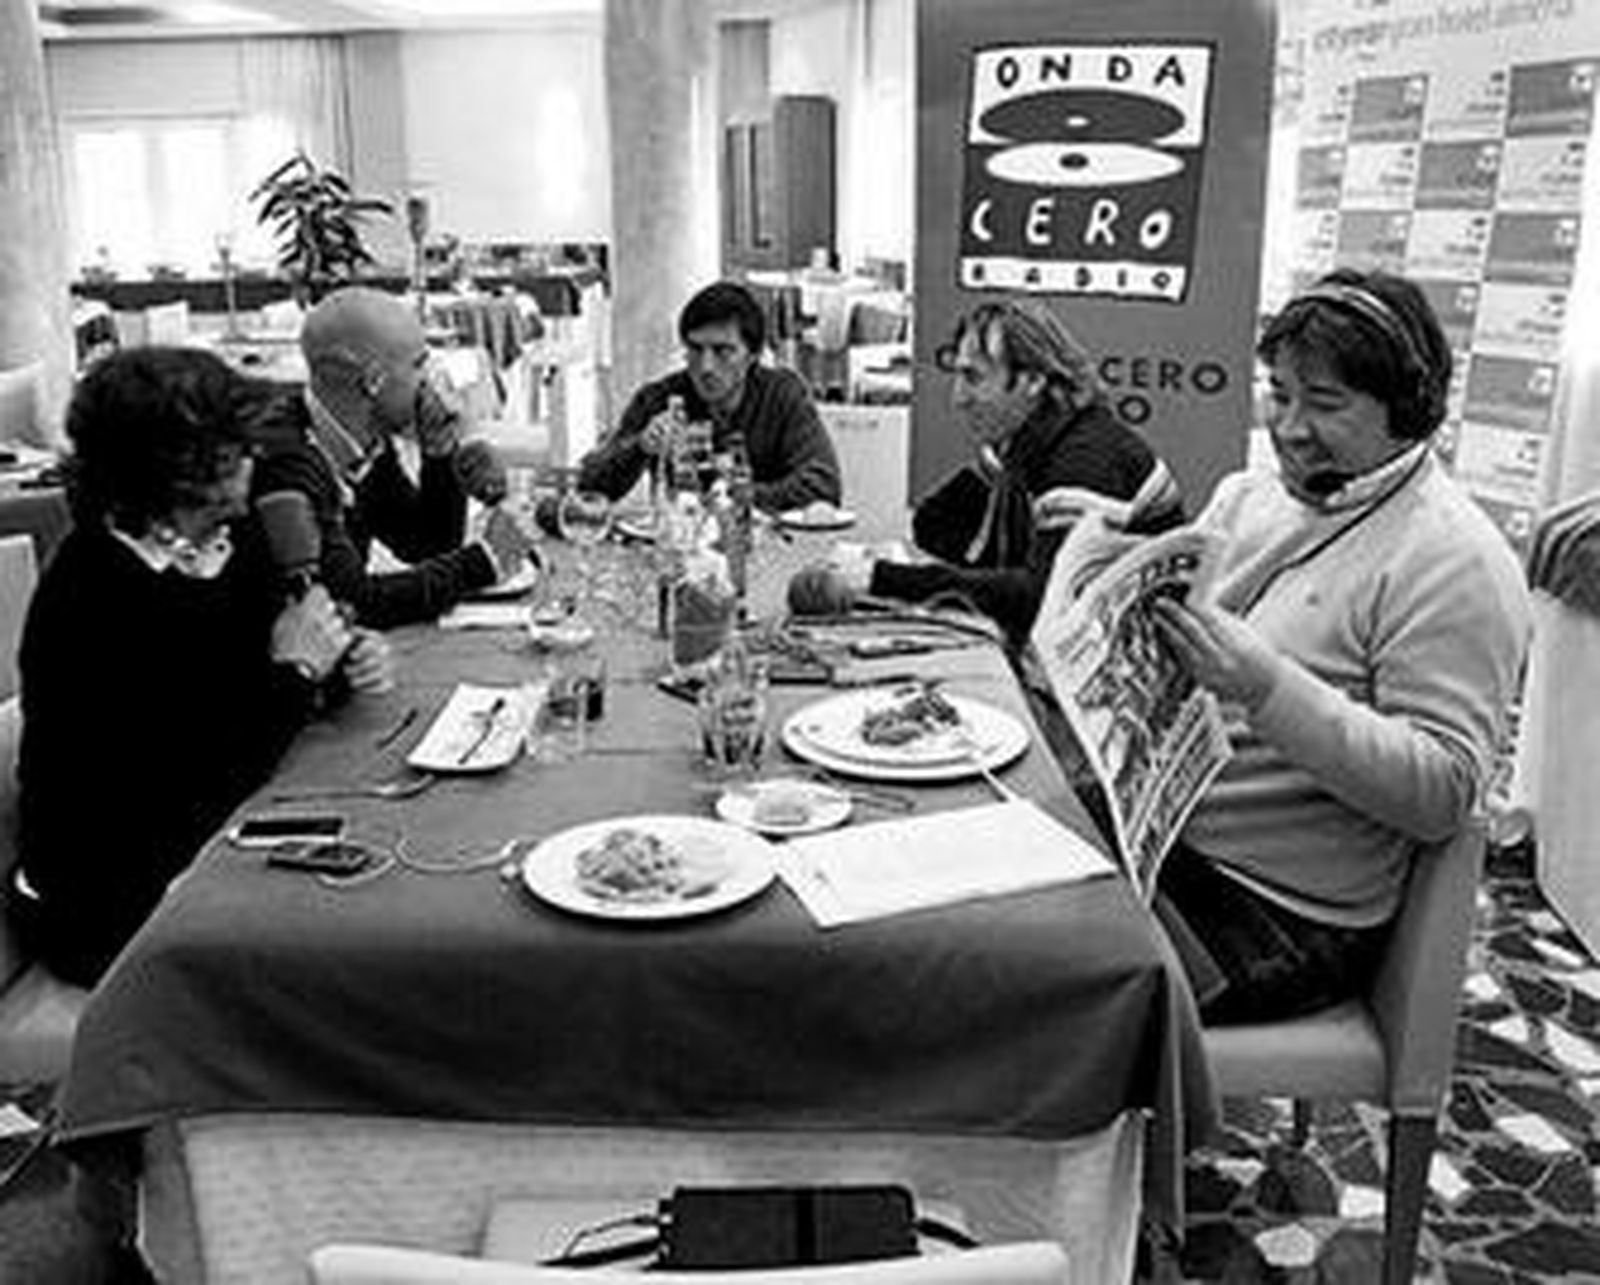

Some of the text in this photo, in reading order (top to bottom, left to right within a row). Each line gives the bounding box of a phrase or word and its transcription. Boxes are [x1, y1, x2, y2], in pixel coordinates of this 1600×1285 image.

[995, 53, 1186, 88] ONDA
[970, 198, 1173, 250] CERO
[971, 263, 1171, 290] RADIO
[1099, 356, 1228, 394] CERO
